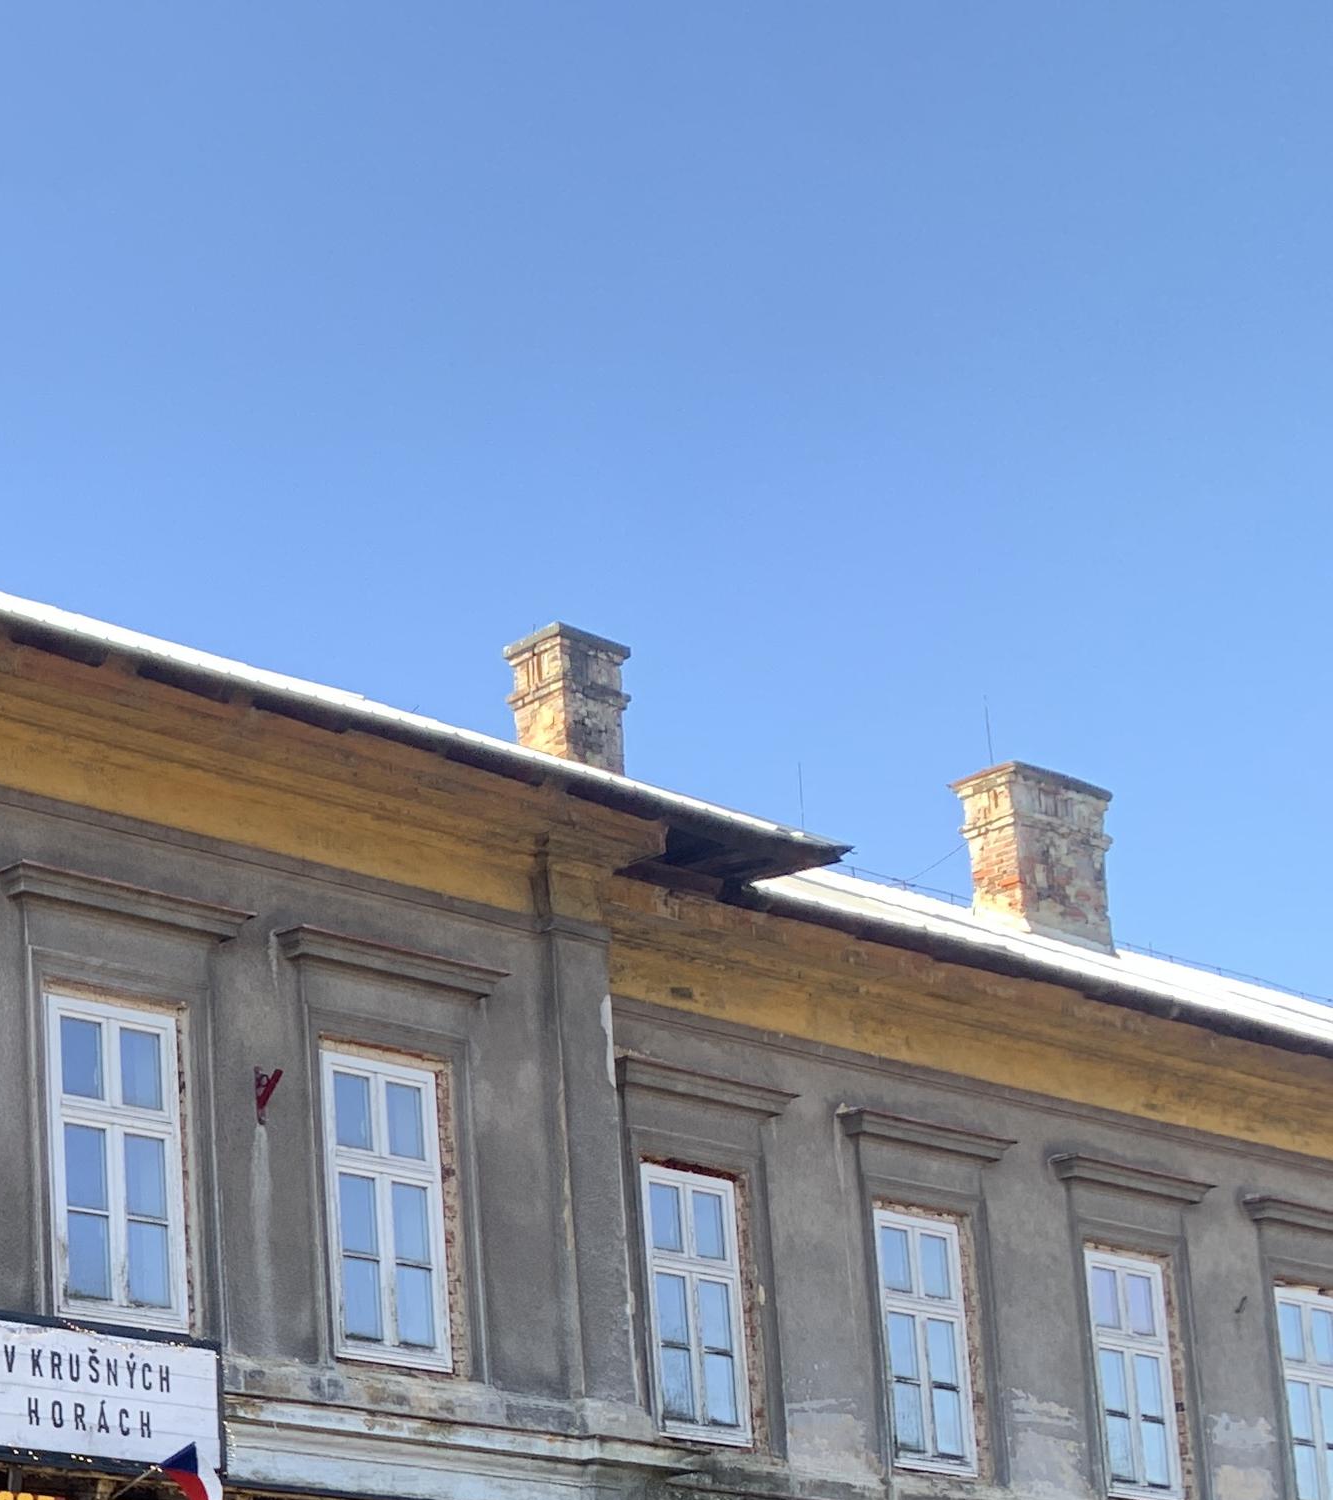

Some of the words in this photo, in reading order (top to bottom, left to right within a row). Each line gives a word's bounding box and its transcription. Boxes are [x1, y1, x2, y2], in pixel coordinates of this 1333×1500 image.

[4, 1344, 16, 1373] V
[30, 1346, 171, 1394] KRUŠNÝCH
[28, 1397, 153, 1440] HORÁCH
